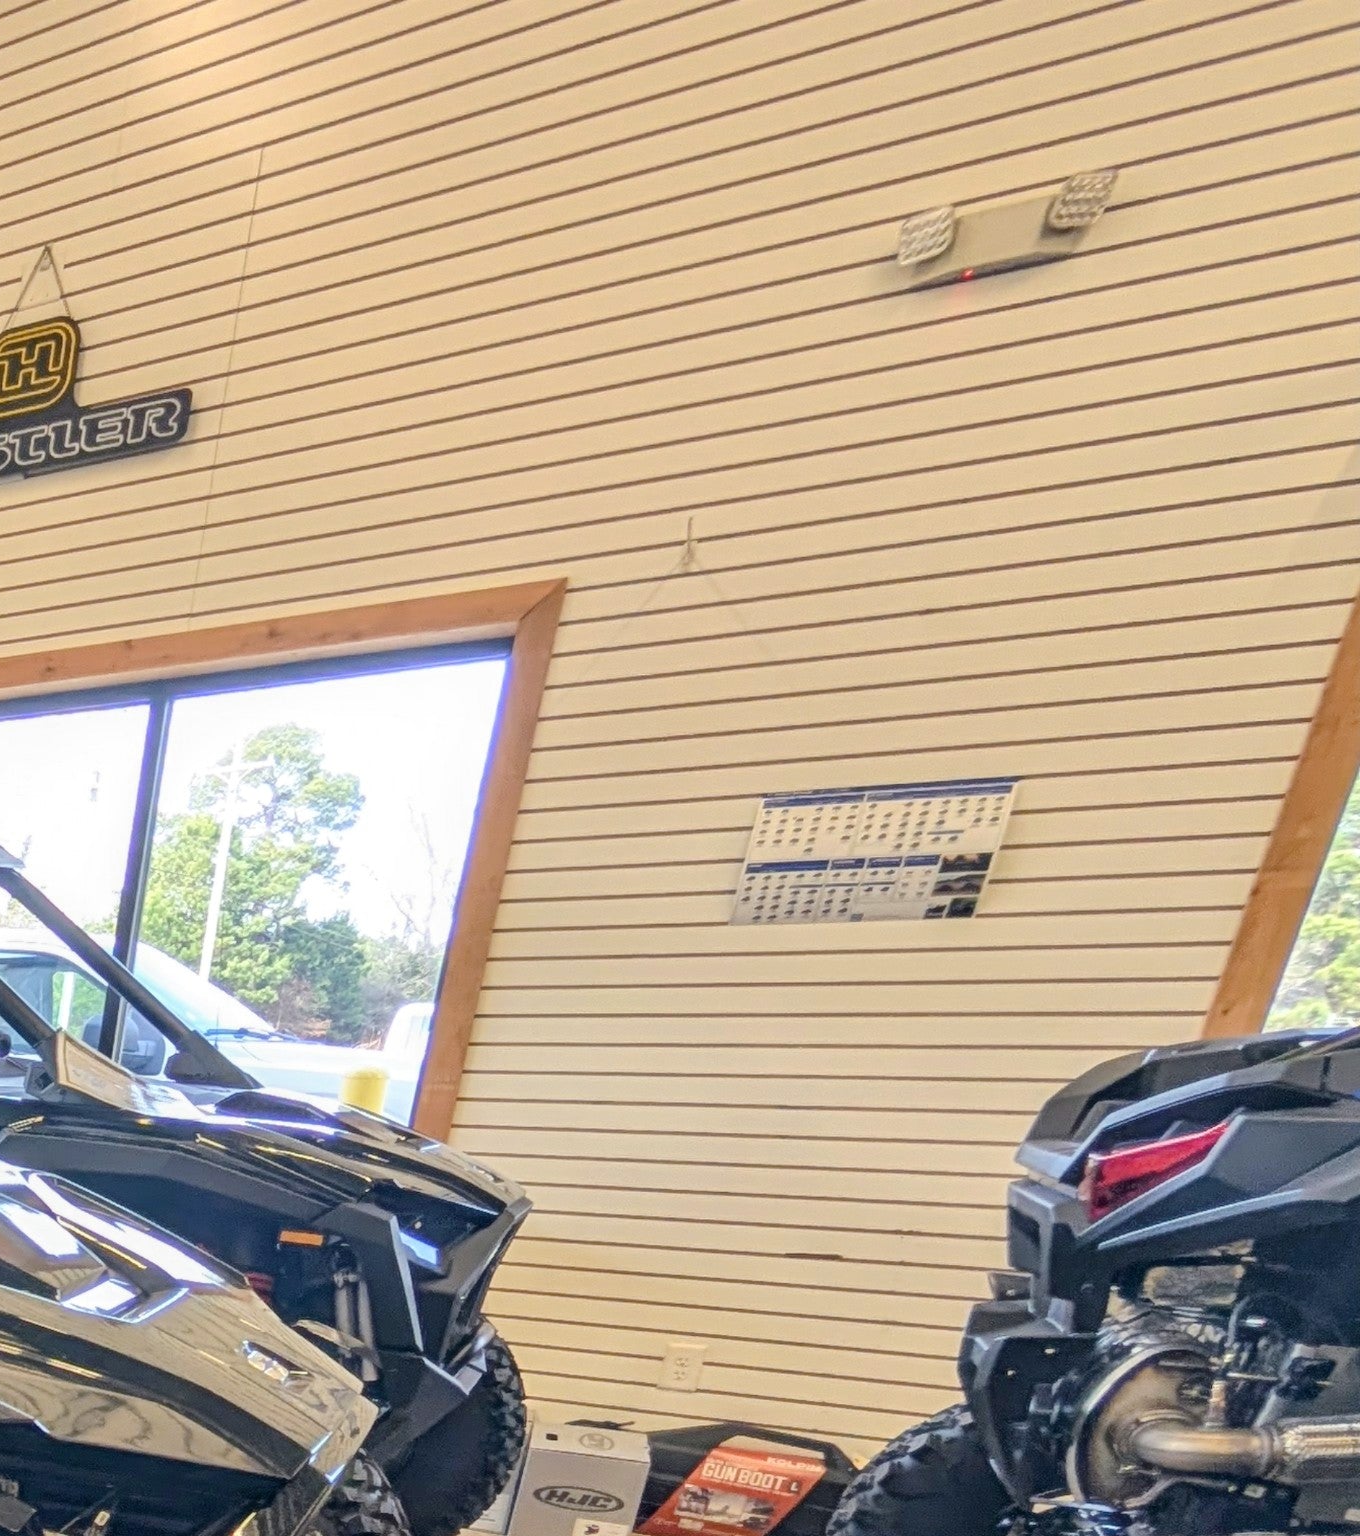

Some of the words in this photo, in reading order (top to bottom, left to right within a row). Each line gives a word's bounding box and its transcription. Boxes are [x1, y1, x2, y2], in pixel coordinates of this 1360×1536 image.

[702, 1461, 738, 1481] GUN
[738, 1467, 789, 1490] BOOT
[544, 1489, 614, 1509] HJC
